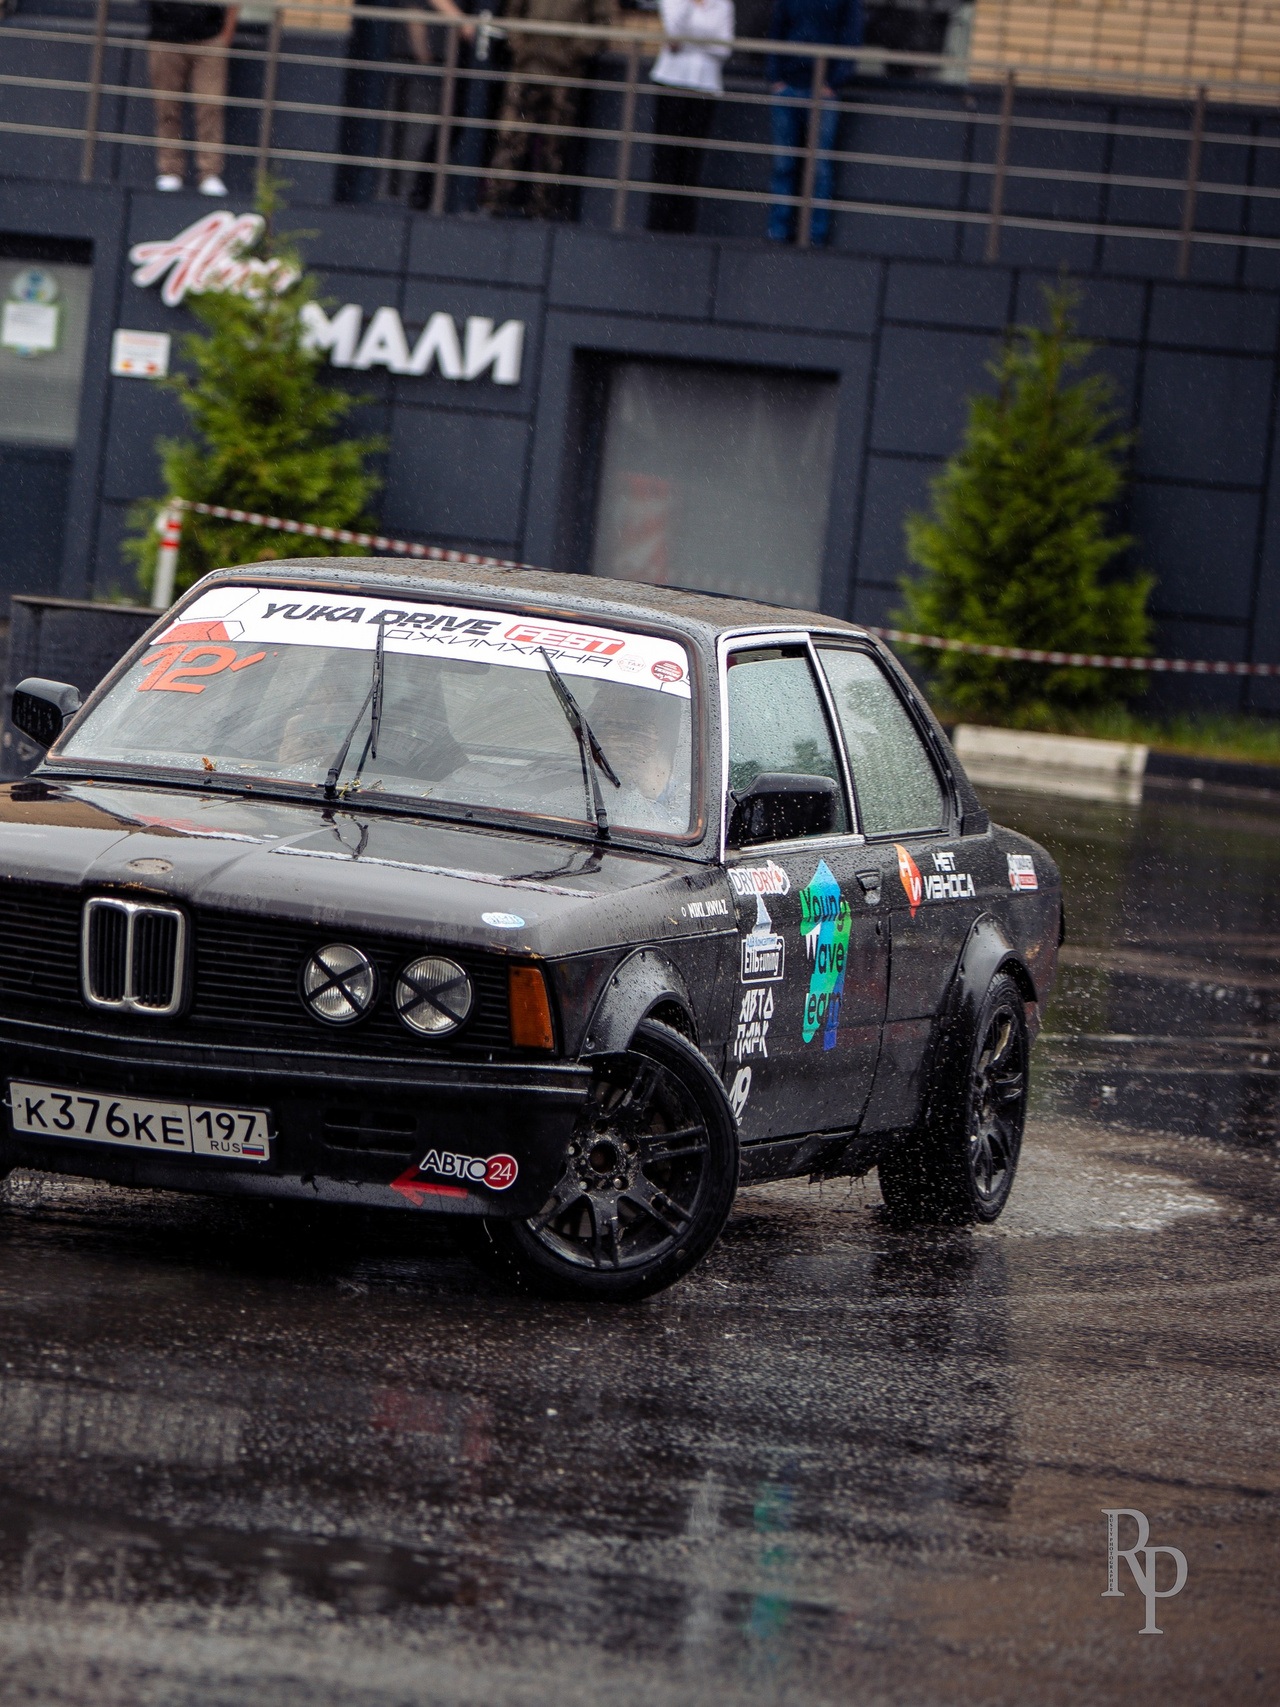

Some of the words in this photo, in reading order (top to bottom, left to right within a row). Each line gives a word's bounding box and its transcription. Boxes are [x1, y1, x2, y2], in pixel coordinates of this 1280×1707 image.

[261, 603, 366, 624] YUKA
[365, 608, 502, 637] DRIVE
[506, 625, 622, 655] FEST
[383, 629, 614, 668] ДЖИМХАНА
[931, 852, 956, 872] НЕТ
[805, 887, 850, 932] Young
[739, 986, 775, 1023] АВТО
[733, 1020, 769, 1063] ПАРК
[195, 1111, 257, 1143] 197
[210, 1140, 241, 1153] RUS
